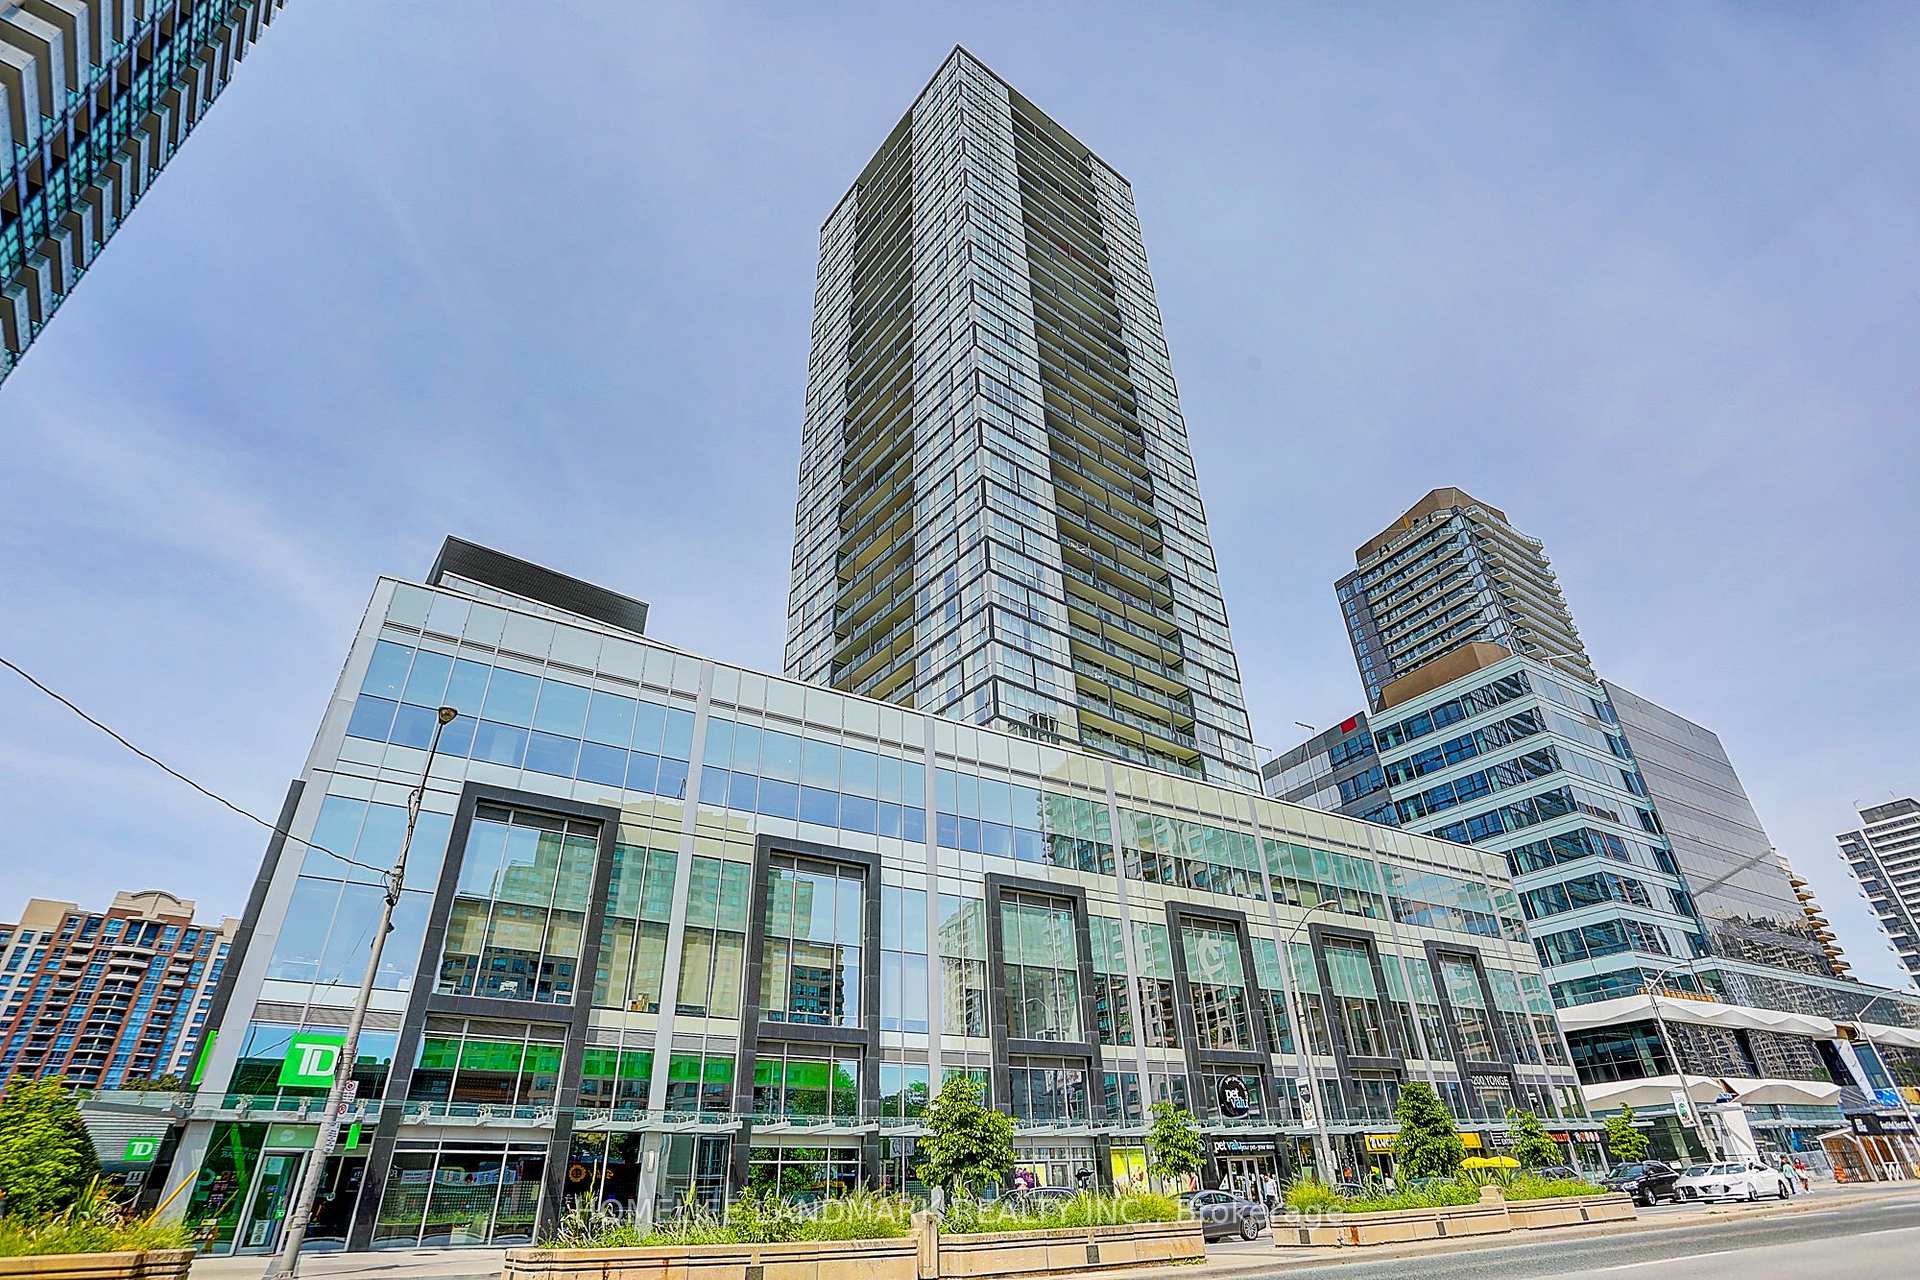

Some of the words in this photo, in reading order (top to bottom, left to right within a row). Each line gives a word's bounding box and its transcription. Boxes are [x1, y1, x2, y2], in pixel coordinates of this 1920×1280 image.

[295, 1043, 341, 1076] TD
[1484, 1075, 1510, 1087] YONGE
[1225, 1088, 1239, 1102] pet
[1231, 1097, 1250, 1109] valu
[131, 1141, 153, 1156] TD
[1214, 1140, 1228, 1153] pet
